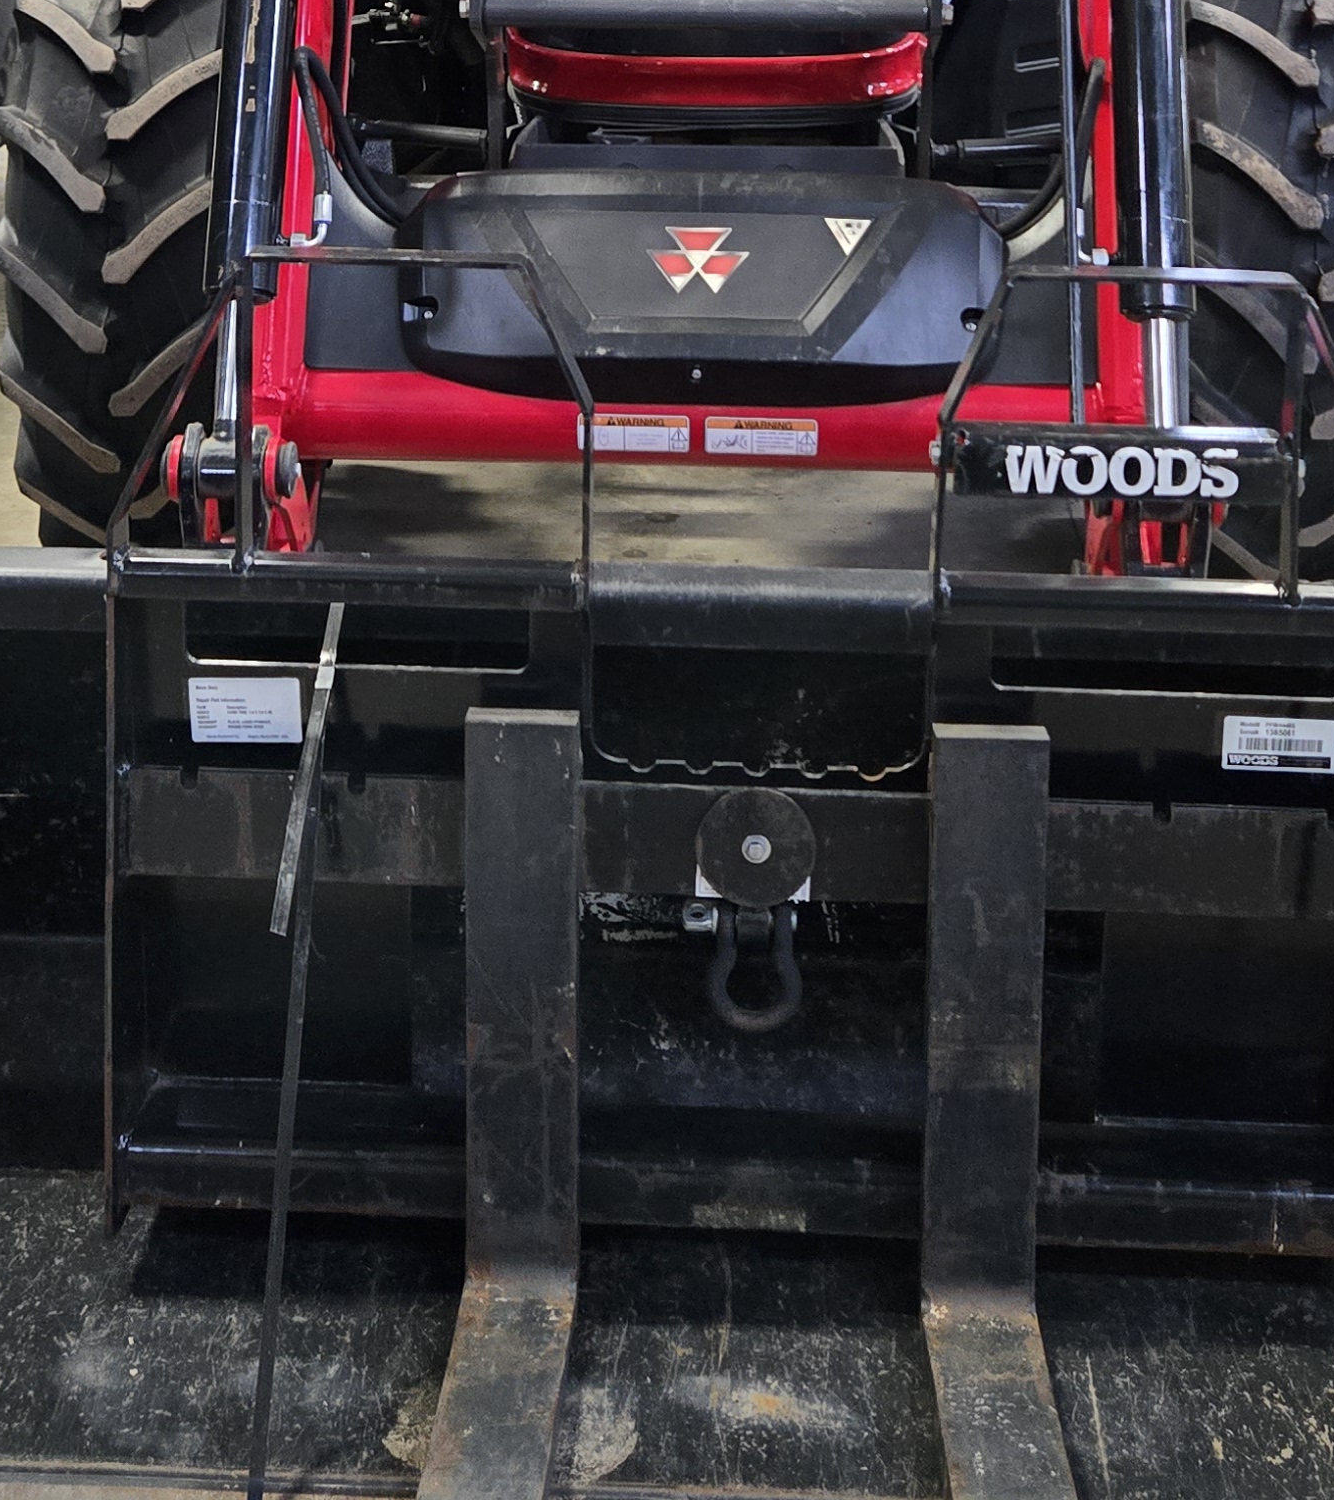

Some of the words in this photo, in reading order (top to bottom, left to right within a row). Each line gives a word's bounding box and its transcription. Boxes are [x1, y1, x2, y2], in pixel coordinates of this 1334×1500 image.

[616, 417, 665, 427] WARNING
[744, 420, 793, 430] WARNING
[1004, 445, 1240, 498] WOODS
[1228, 754, 1279, 766] WOODS
